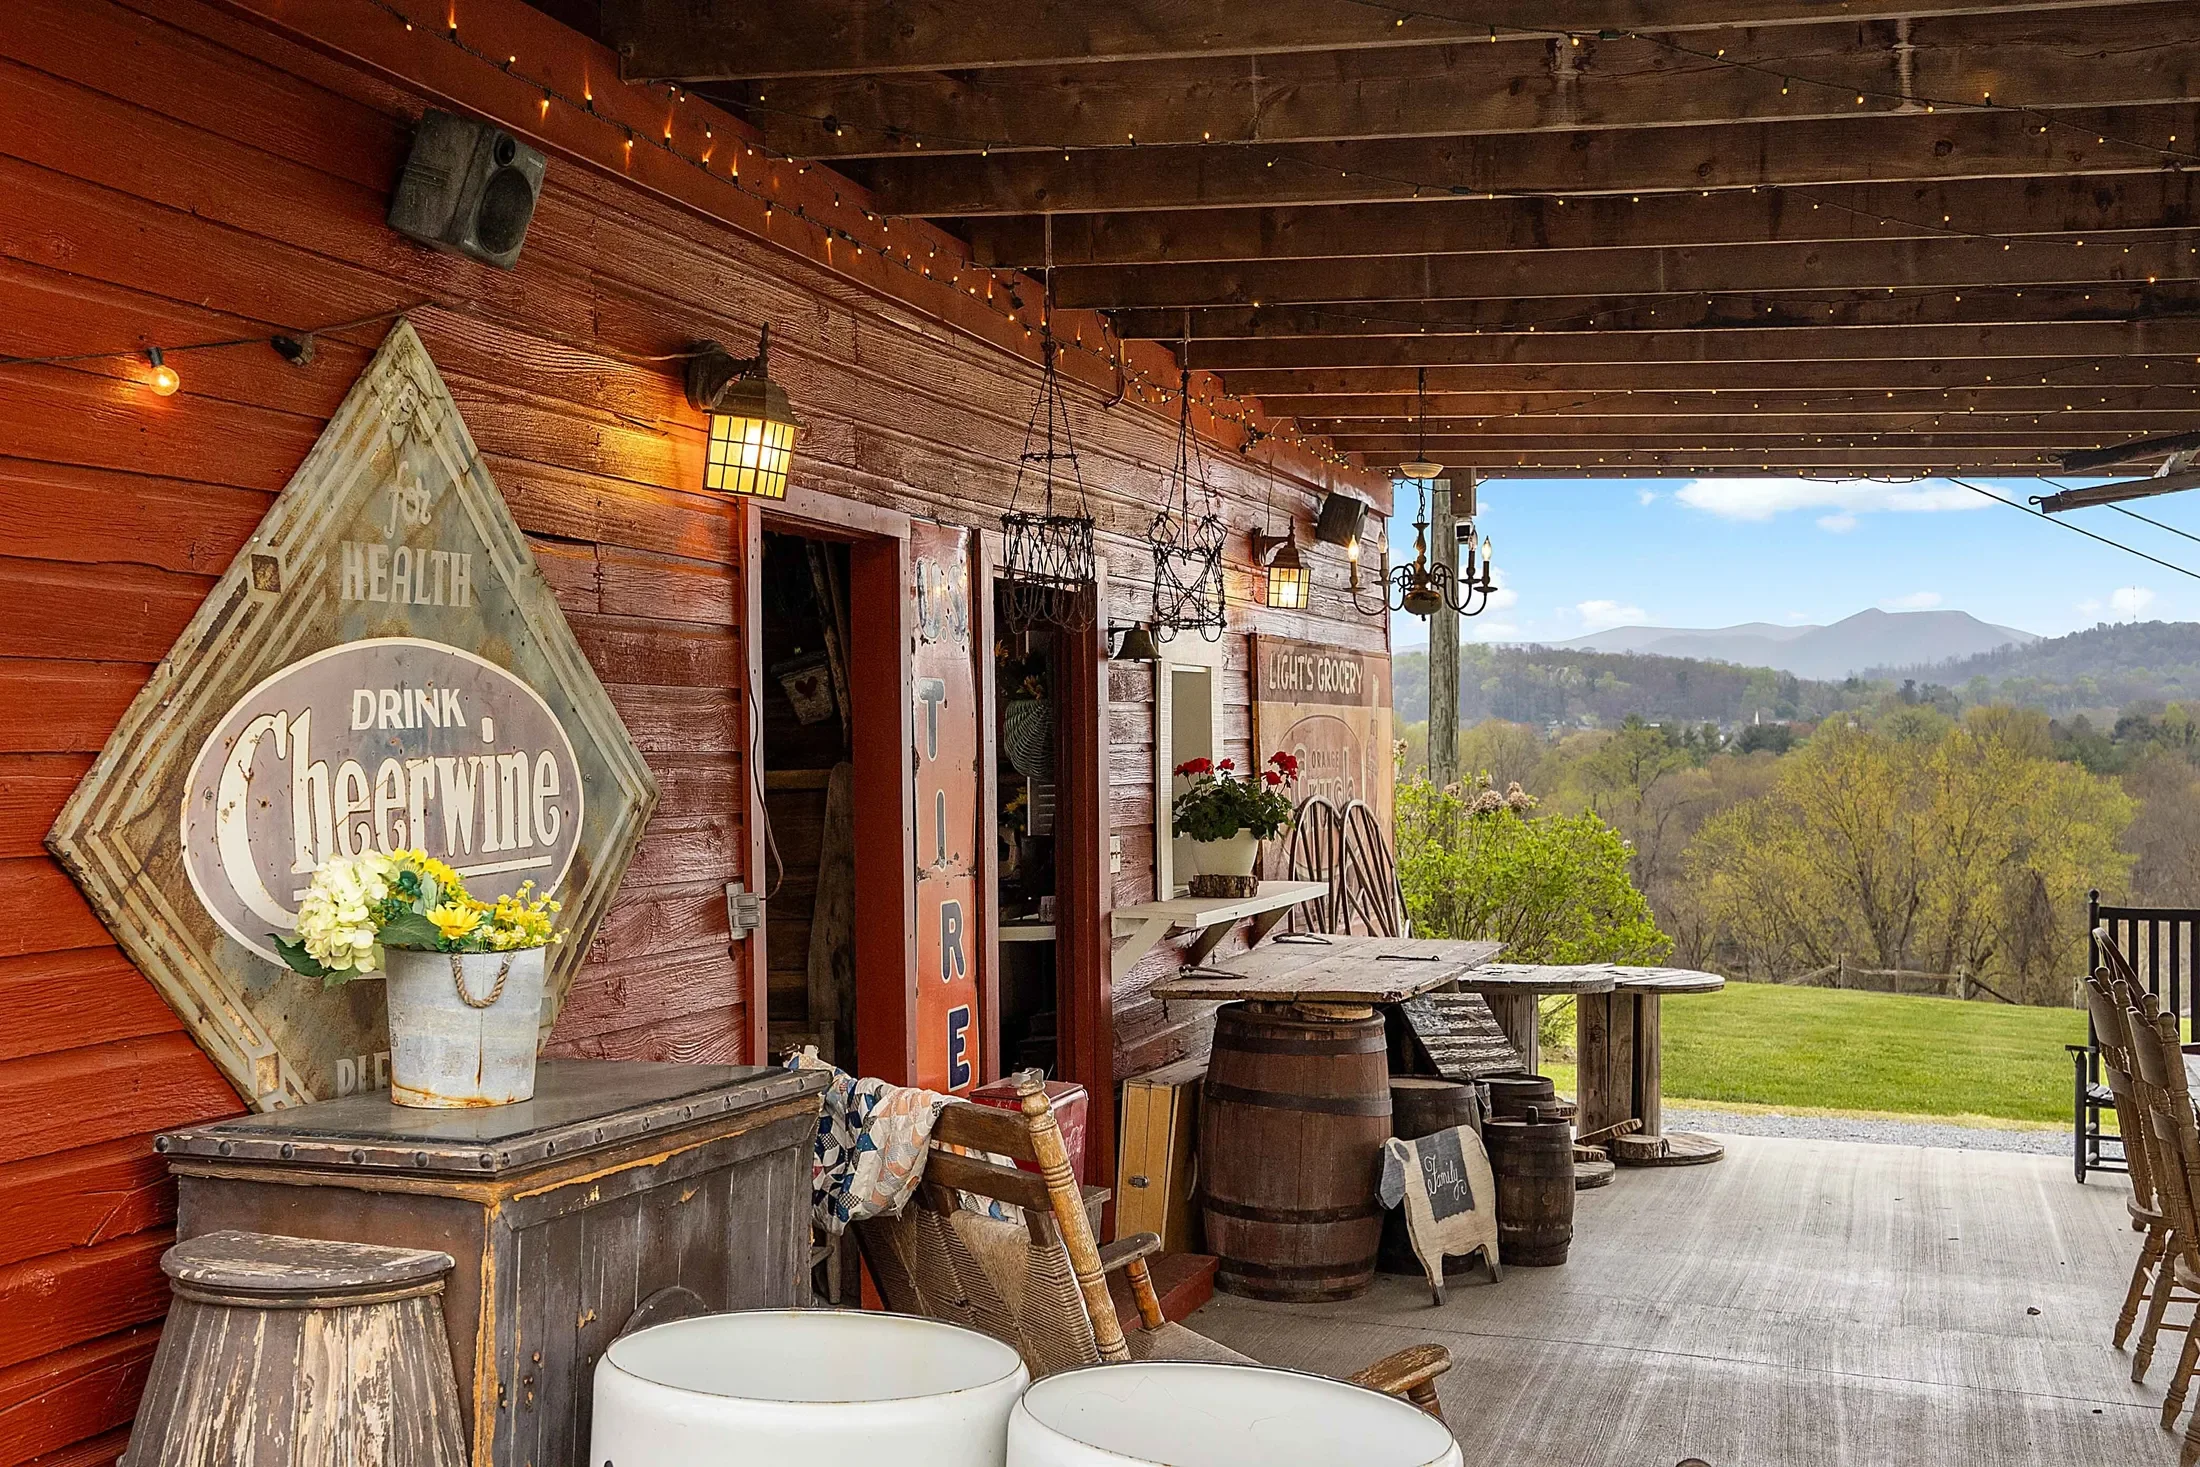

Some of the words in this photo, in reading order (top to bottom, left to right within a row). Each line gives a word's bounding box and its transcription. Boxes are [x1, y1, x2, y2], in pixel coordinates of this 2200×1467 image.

[383, 460, 432, 539] for
[341, 540, 472, 607] HEALTH
[1269, 652, 1314, 691] LIGHT'S
[1317, 657, 1363, 695] GROCERY
[352, 688, 466, 731] DRINK
[1311, 749, 1340, 769] ORANGE
[216, 707, 561, 930] Cheerwine
[1423, 1154, 1467, 1201] Family
